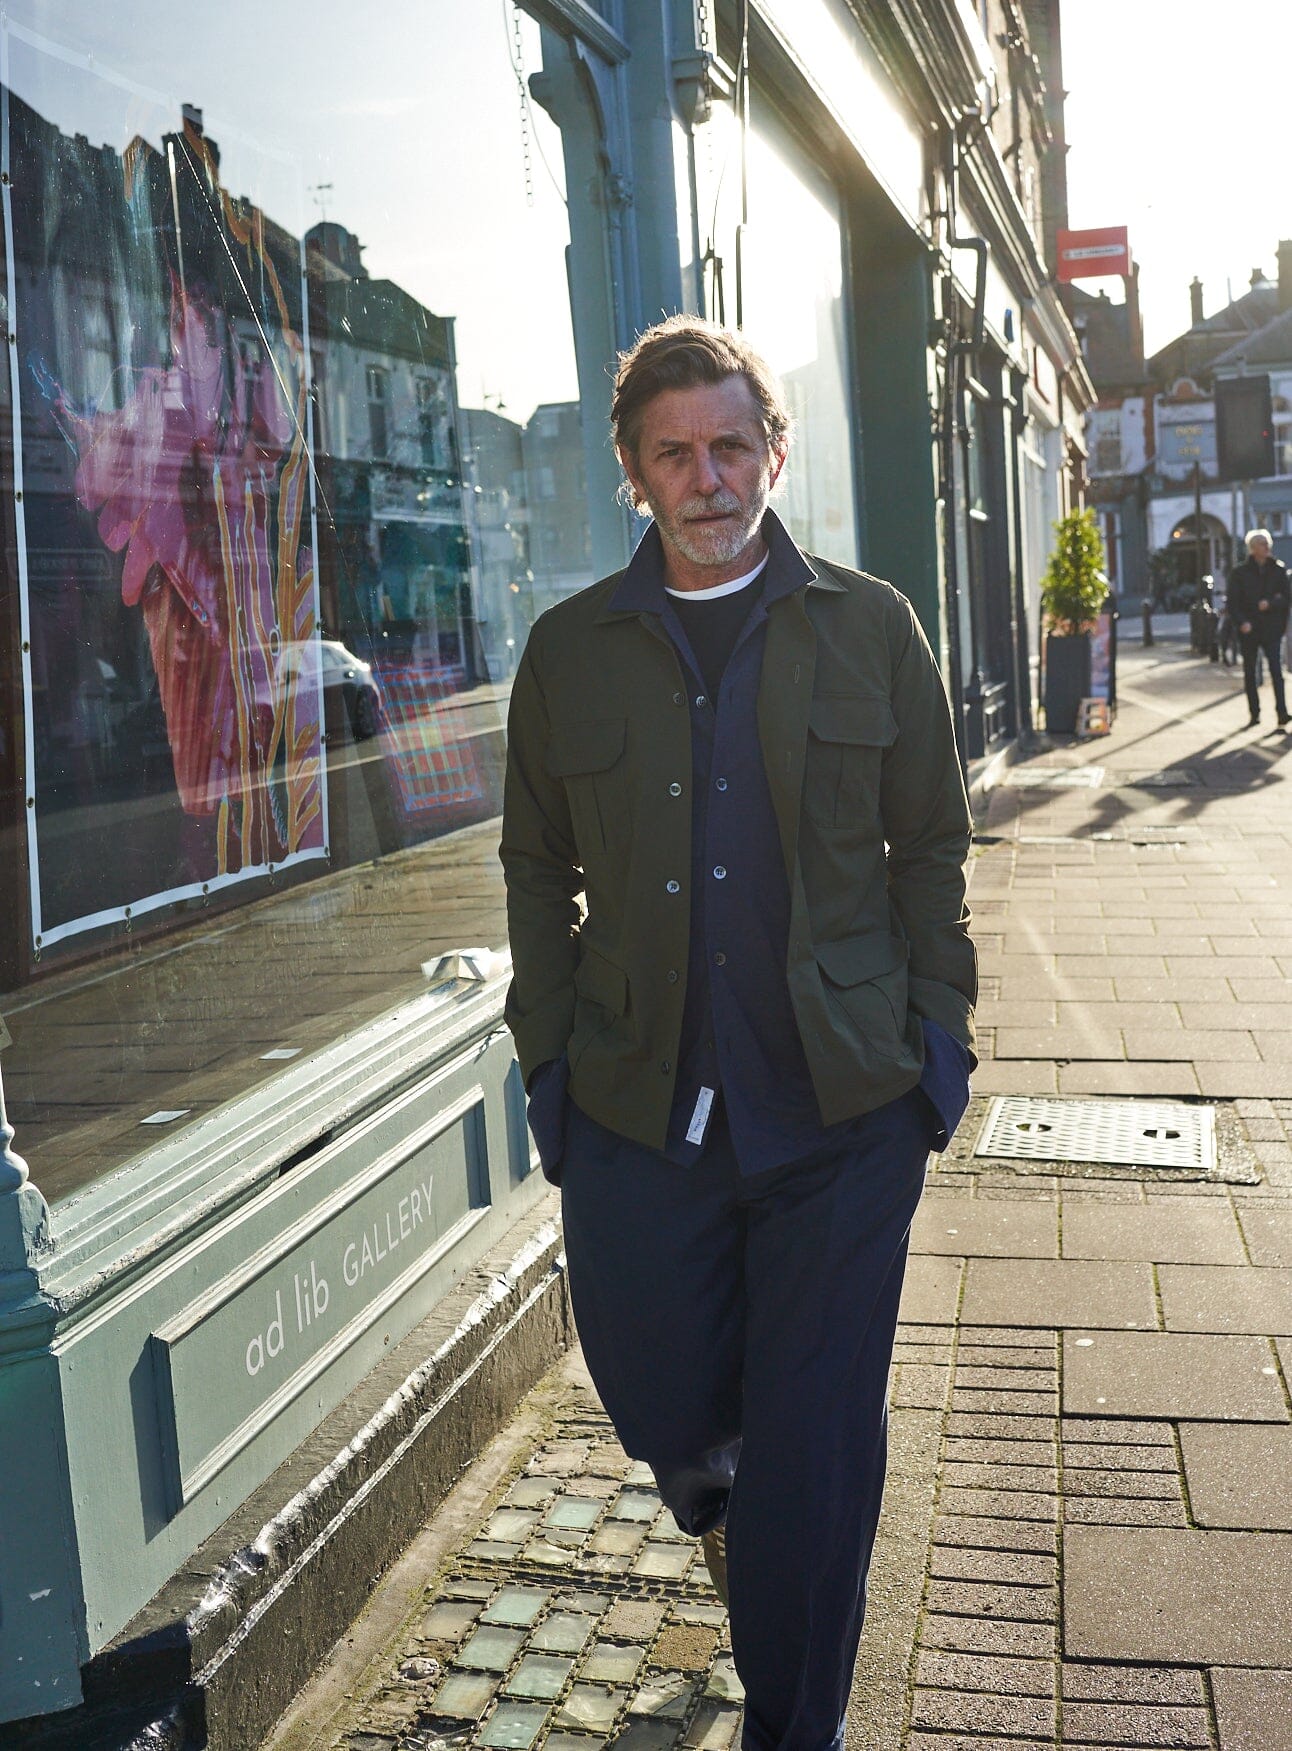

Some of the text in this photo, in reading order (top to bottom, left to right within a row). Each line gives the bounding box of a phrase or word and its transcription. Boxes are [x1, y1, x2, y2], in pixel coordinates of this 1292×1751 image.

[245, 1174, 434, 1376] ad lib GALLERY
